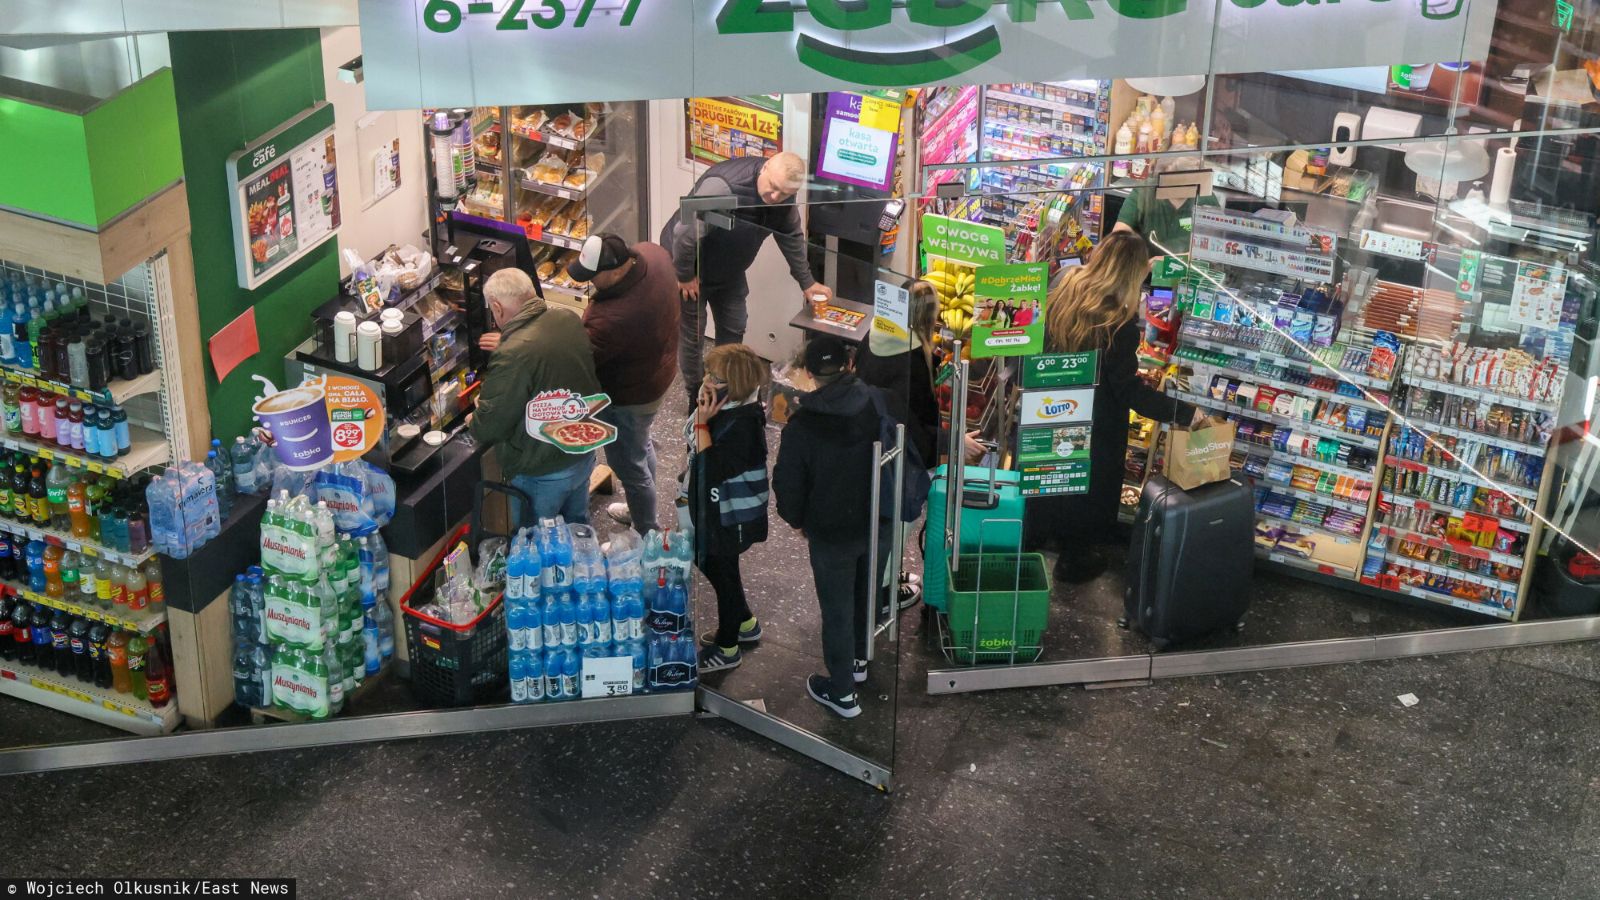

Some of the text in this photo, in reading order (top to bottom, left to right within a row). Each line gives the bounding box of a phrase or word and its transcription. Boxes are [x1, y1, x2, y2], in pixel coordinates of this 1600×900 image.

[694, 107, 735, 126] DRUGIE
[735, 117, 751, 130] ZA
[750, 113, 757, 131] 1
[849, 127, 872, 142] kasa
[838, 138, 879, 153] otwarta
[249, 176, 271, 196] MEAL
[936, 225, 989, 244] owoce
[927, 236, 999, 260] warzywa
[568, 404, 576, 414] 3
[1045, 402, 1071, 415] LOTTO
[710, 487, 720, 502] S
[263, 537, 306, 560] Muszynianka
[267, 608, 310, 630] Muszynianka
[979, 638, 1017, 649] żabka
[274, 675, 317, 698] Muszynianka
